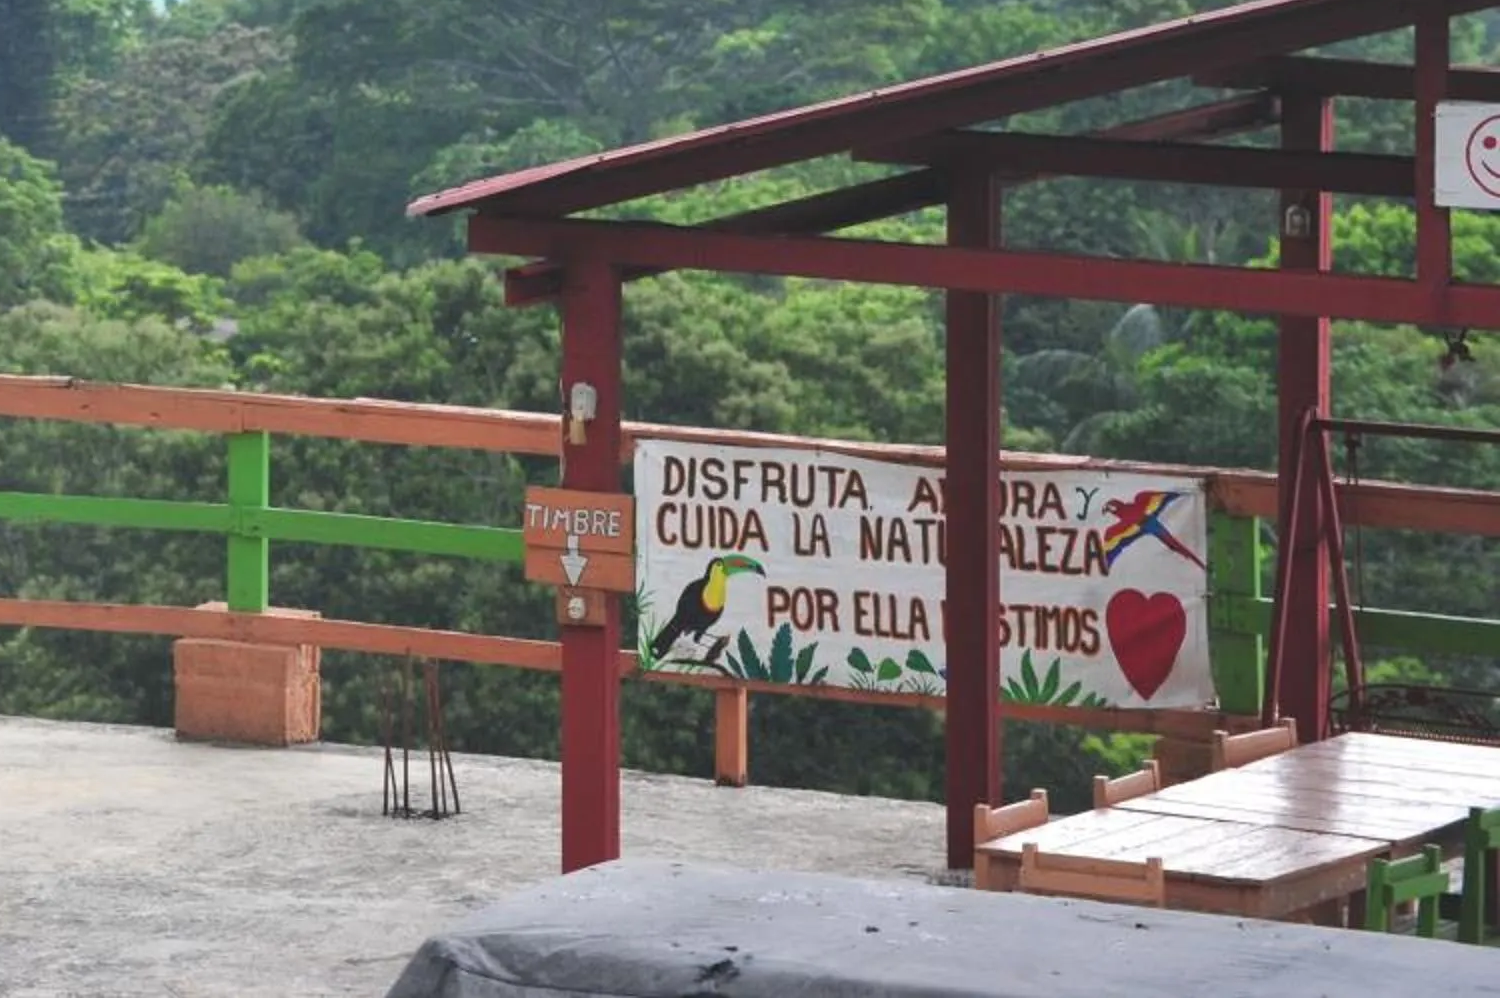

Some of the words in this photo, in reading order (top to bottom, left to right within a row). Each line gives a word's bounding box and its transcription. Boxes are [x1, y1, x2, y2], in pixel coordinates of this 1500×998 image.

[527, 504, 622, 537] TIMBRE
[656, 502, 769, 553] CUIDA
[793, 512, 831, 558] LA
[766, 586, 840, 633] POR
[852, 590, 930, 641] ELLA
